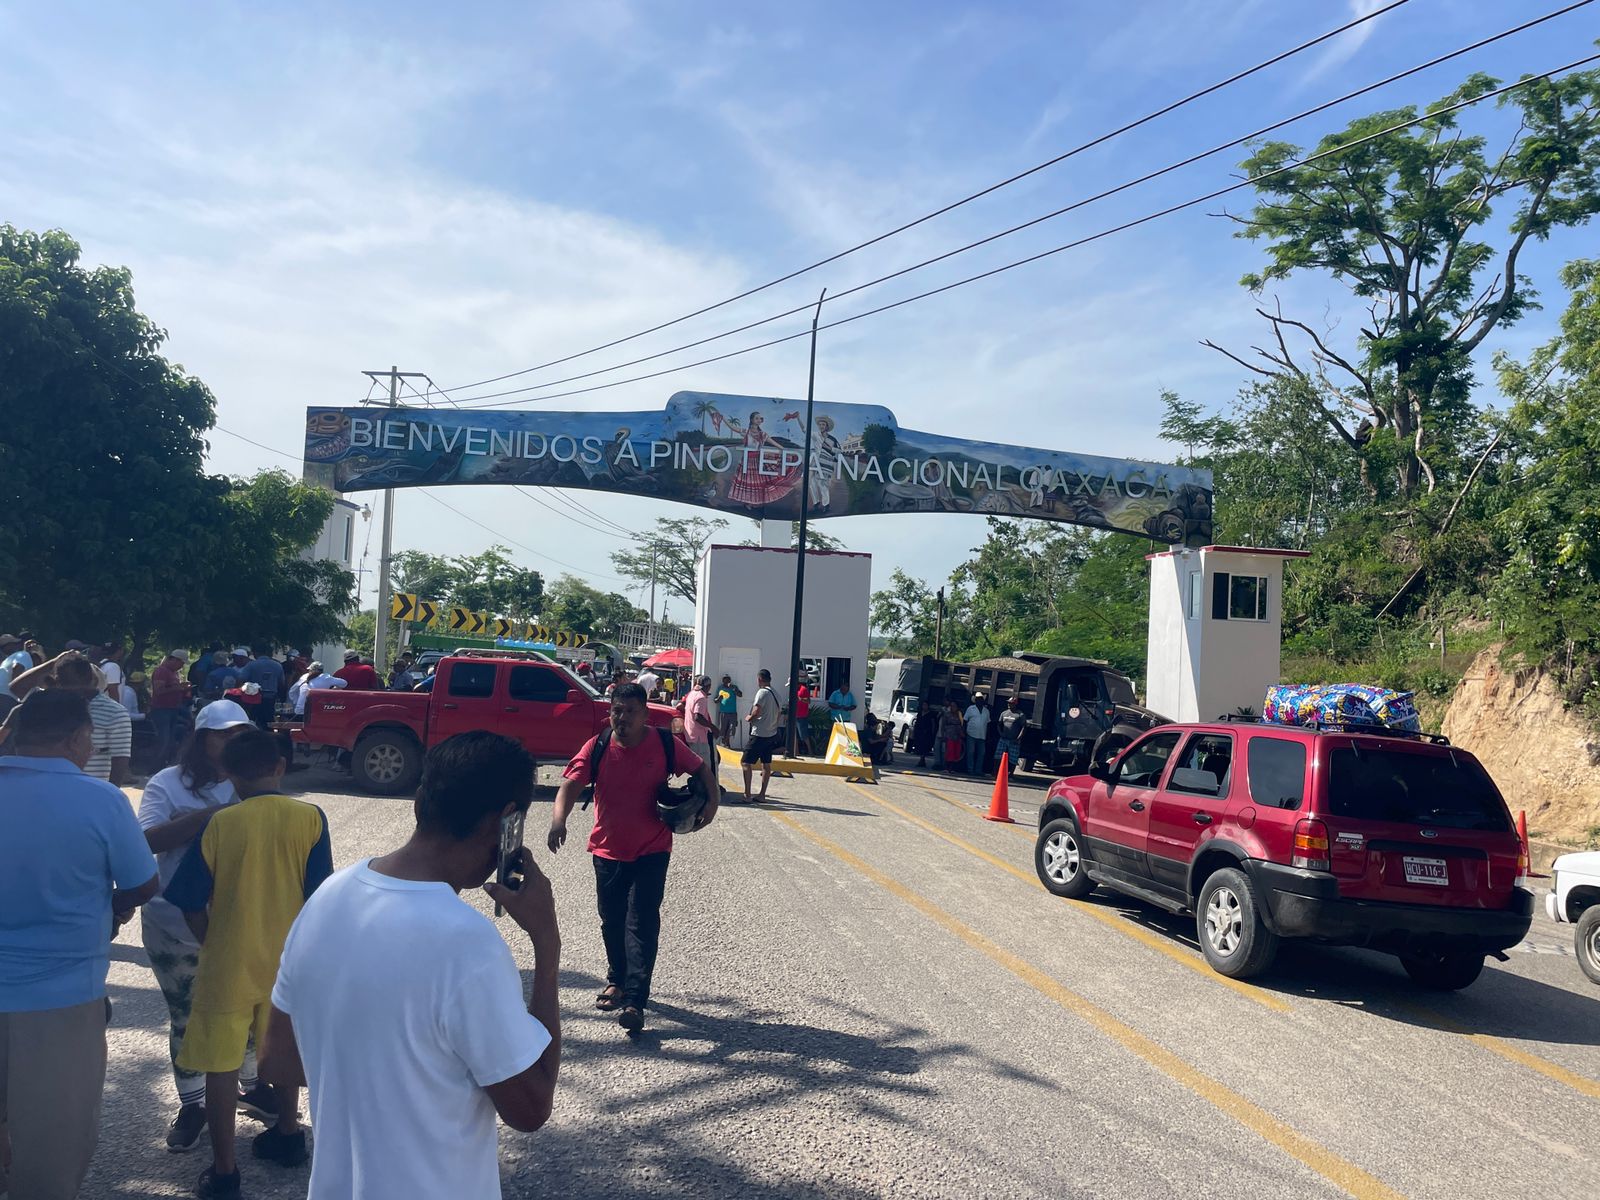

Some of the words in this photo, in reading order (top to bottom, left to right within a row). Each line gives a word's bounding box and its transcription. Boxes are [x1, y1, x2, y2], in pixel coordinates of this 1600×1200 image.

[350, 417, 603, 464] BIENVENIDOS
[613, 439, 639, 467] A
[650, 440, 824, 480] PINOTEPA
[836, 453, 1011, 493] NACIONAL
[1020, 465, 1172, 500] OAXACA
